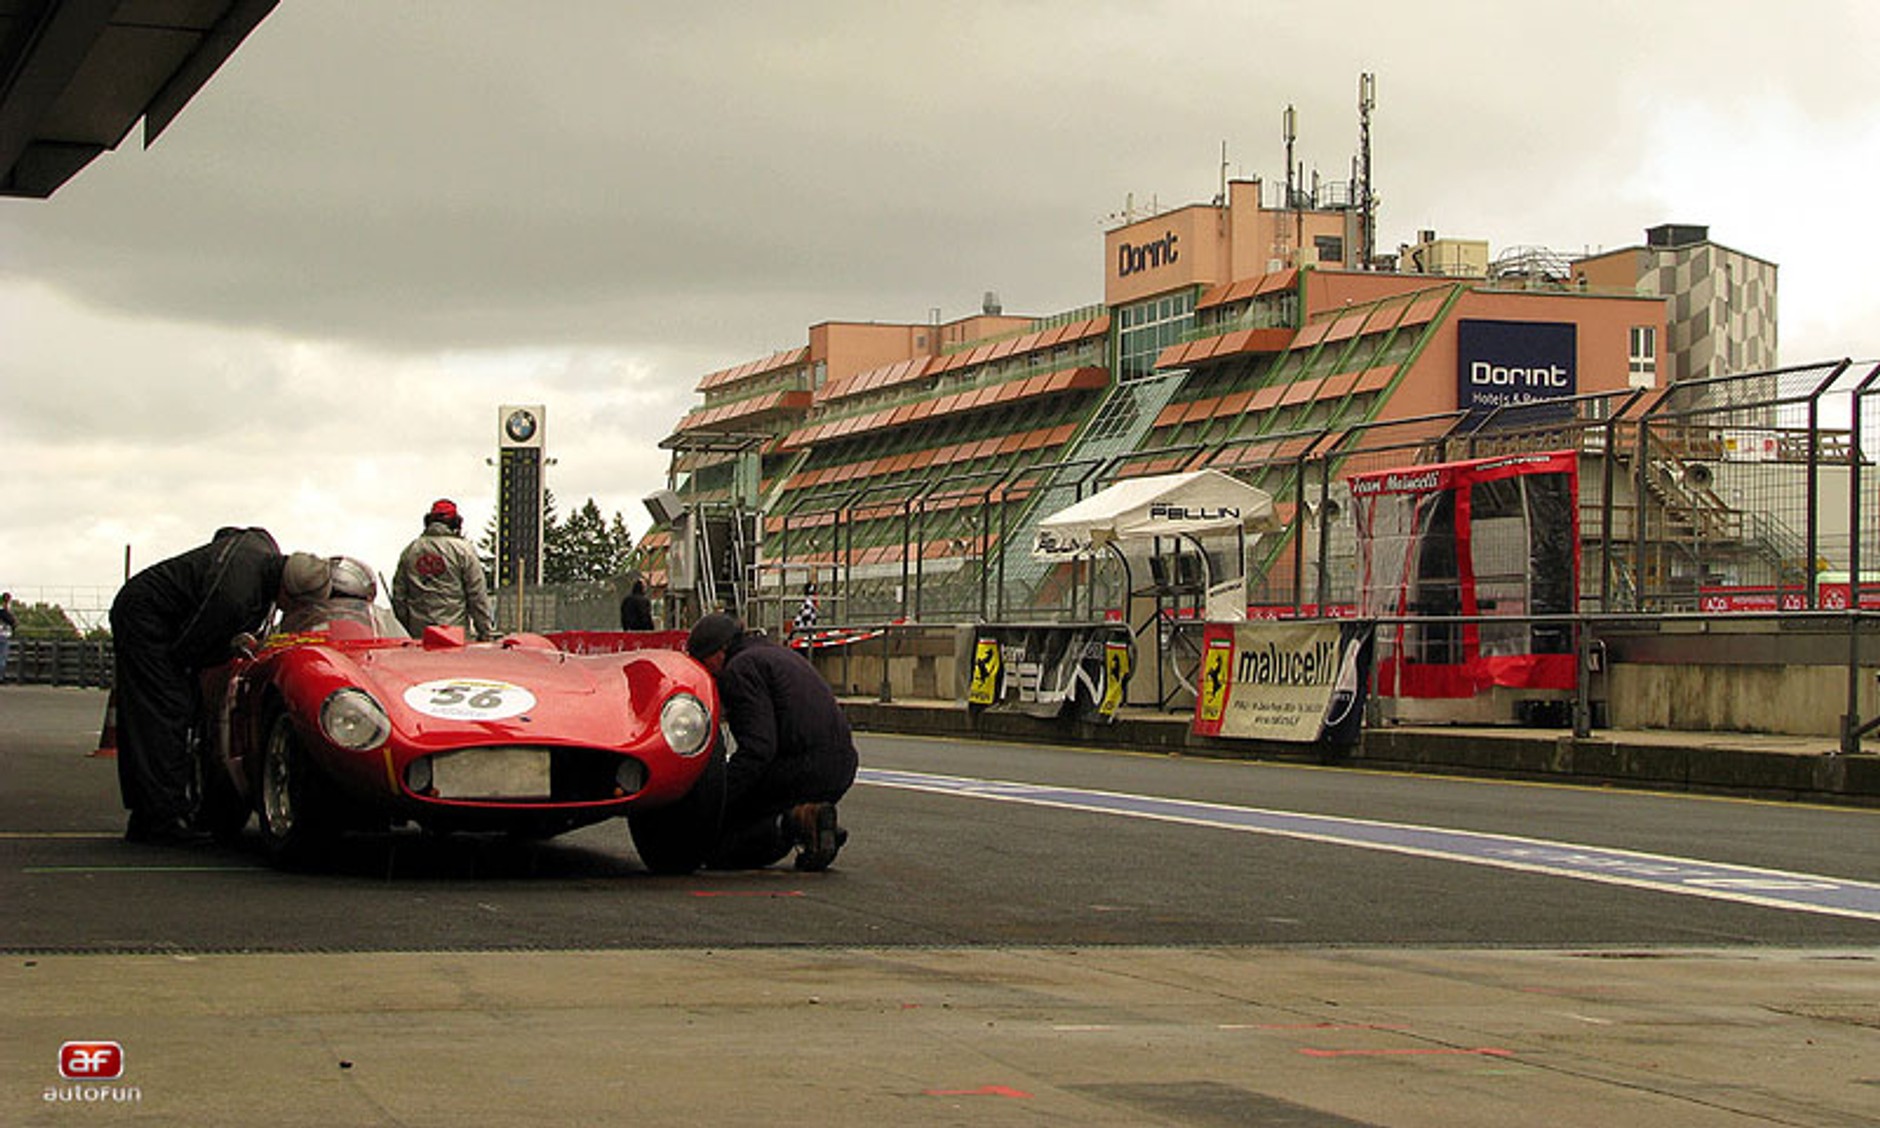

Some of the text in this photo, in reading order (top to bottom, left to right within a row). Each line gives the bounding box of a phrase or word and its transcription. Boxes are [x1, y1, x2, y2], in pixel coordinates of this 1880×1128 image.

[1119, 231, 1178, 277] Dorint
[1471, 361, 1567, 387] Dorint
[1151, 507, 1240, 520] PELLIN
[1238, 641, 1336, 687] malucelli
[429, 685, 503, 709] 56
